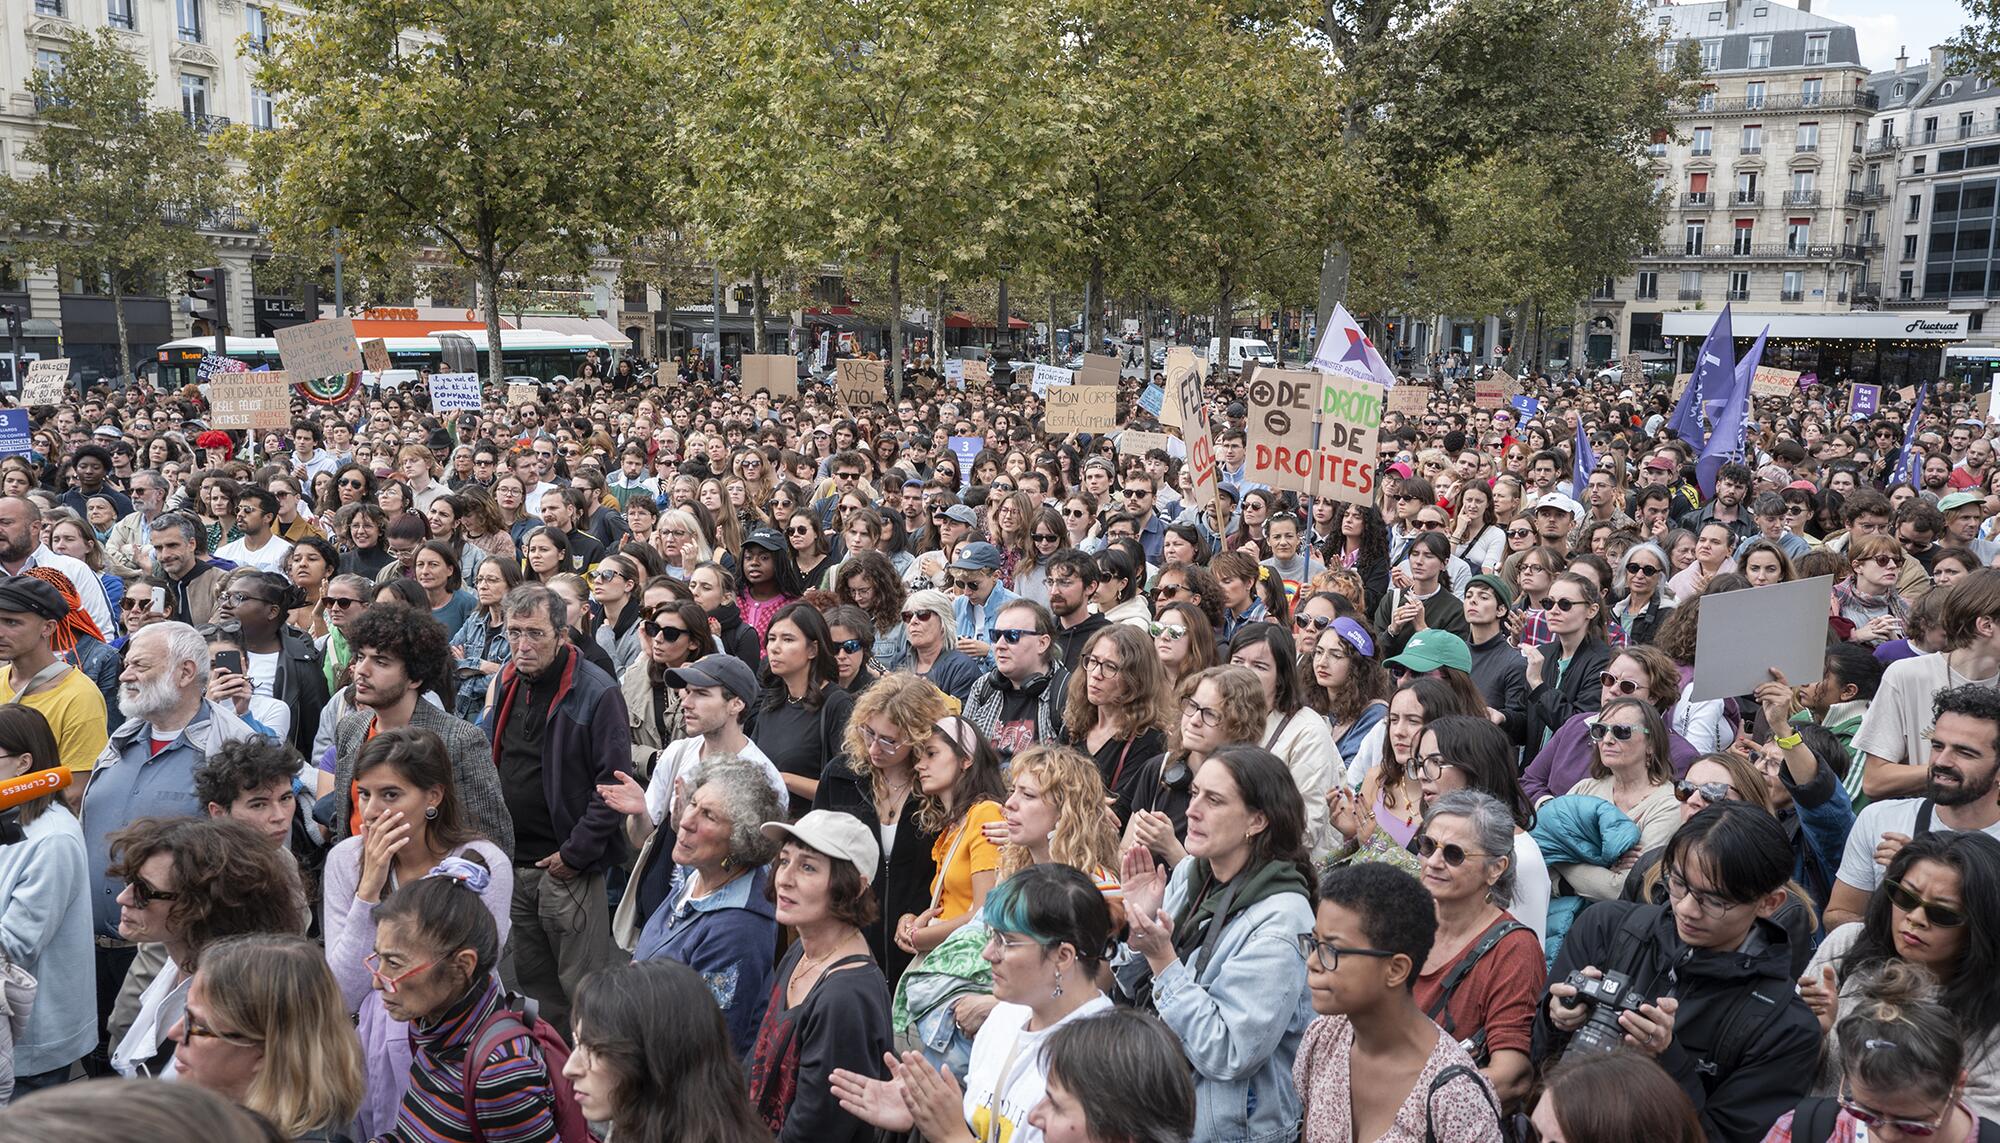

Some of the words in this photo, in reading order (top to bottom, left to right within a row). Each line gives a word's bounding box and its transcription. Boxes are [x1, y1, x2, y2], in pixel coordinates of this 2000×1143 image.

[364, 308, 418, 320] POPEYES
[1905, 320, 1959, 333] Fluctuat
[245, 373, 255, 384] EN
[843, 362, 878, 382] RAS
[212, 389, 220, 399] ET
[224, 386, 263, 399] SOLIDAIRES
[265, 386, 284, 398] AVEC
[840, 390, 875, 406] VIOL
[1047, 388, 1079, 403] MON
[1083, 386, 1116, 406] CORPS
[1276, 380, 1311, 409] DE
[1521, 398, 1528, 407] 3
[0, 414, 9, 426] 3
[1331, 422, 1366, 454] DE
[962, 441, 969, 452] 3
[2, 778, 46, 796] CLPRESS
